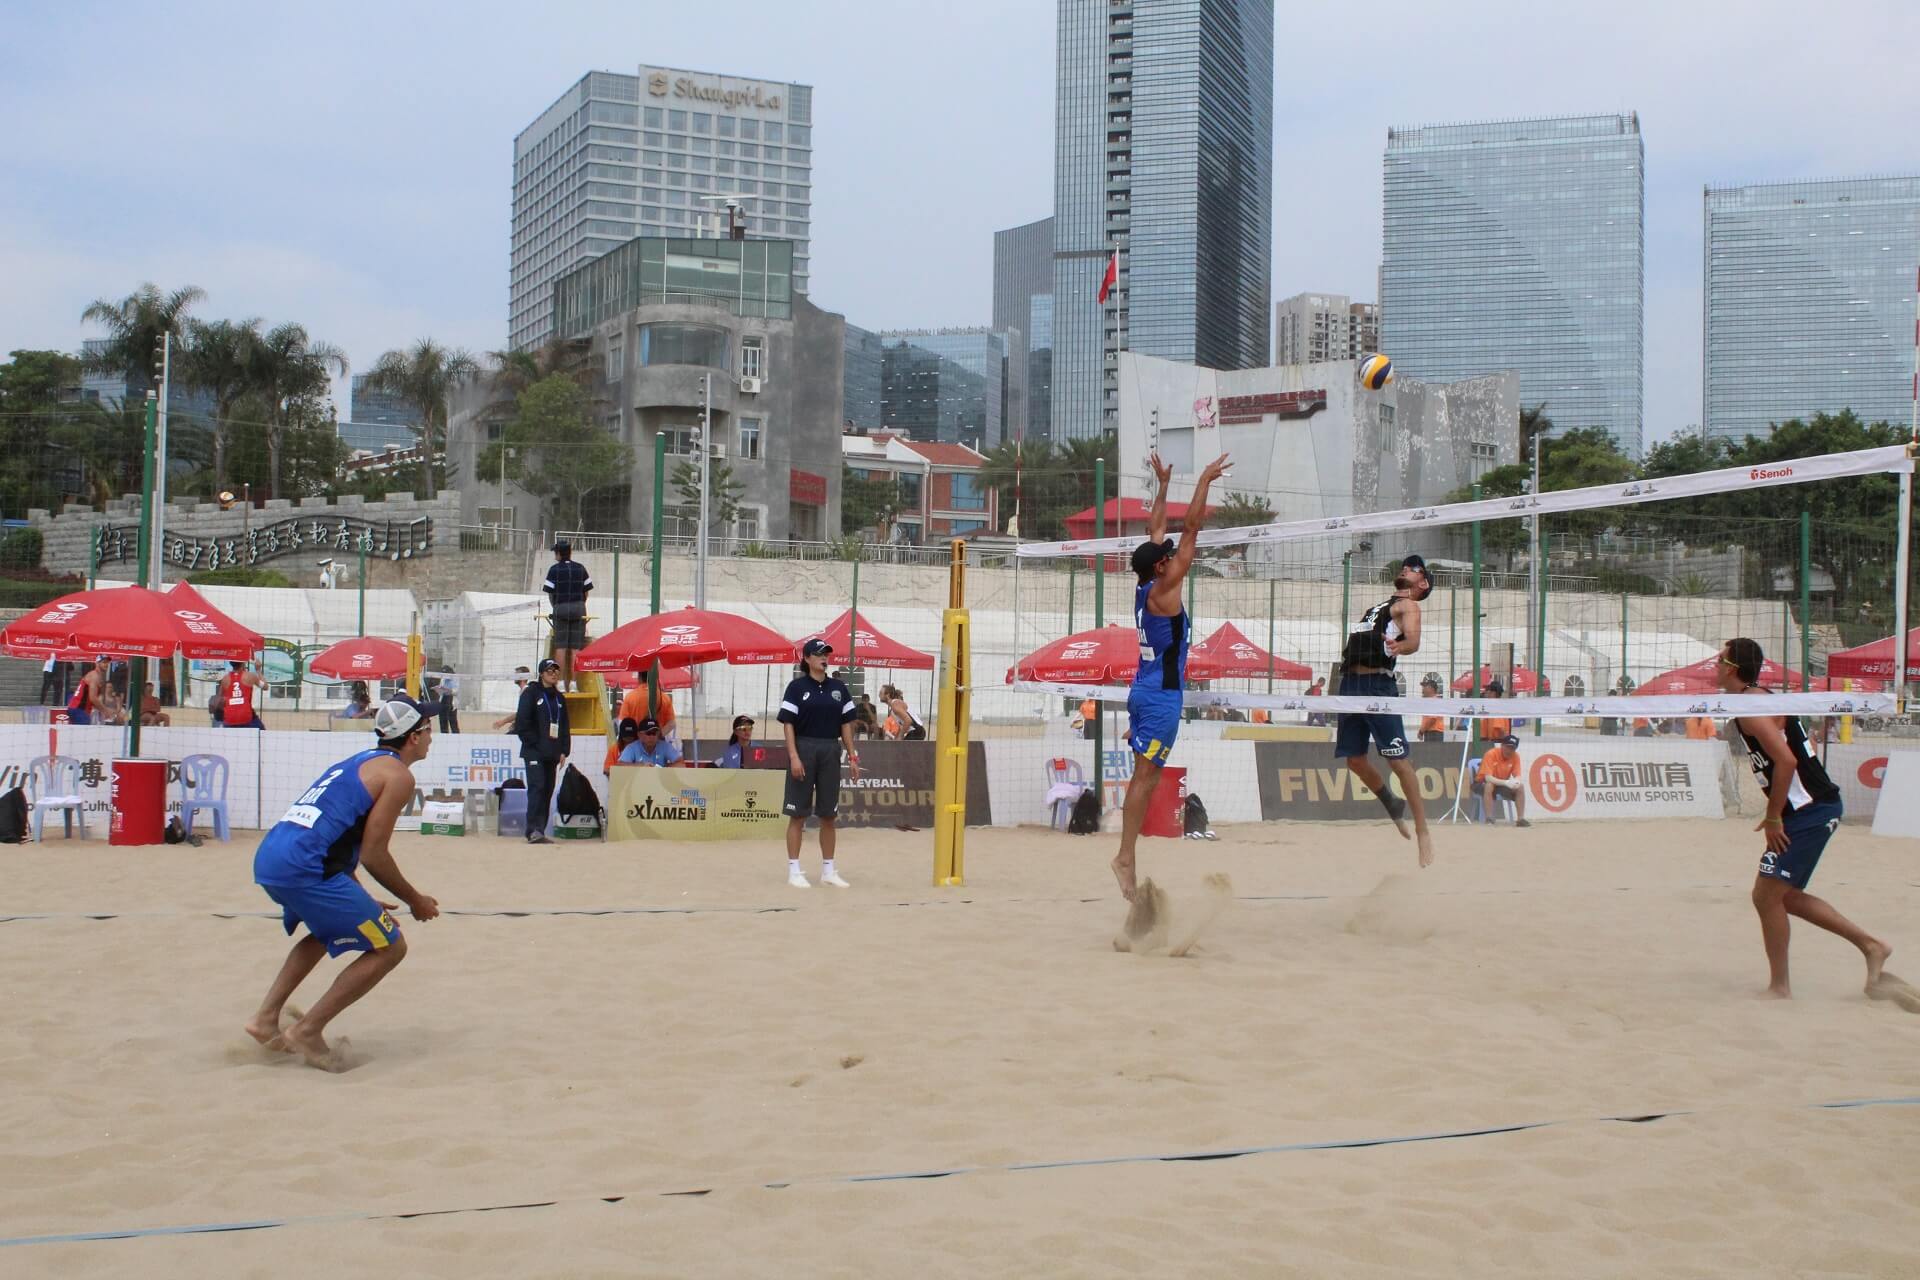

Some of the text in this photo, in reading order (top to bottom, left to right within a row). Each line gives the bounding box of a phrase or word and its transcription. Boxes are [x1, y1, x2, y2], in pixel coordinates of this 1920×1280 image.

[1759, 467, 1793, 480] Senoh
[233, 682, 241, 691] 2
[472, 749, 511, 766] 思明
[319, 769, 343, 787] 2
[1581, 762, 1692, 788] 迈冠体育
[838, 779, 904, 788] LLEYBALL
[1585, 790, 1694, 803] MAGNUM SPORTS
[627, 796, 698, 821] XIAMEN
